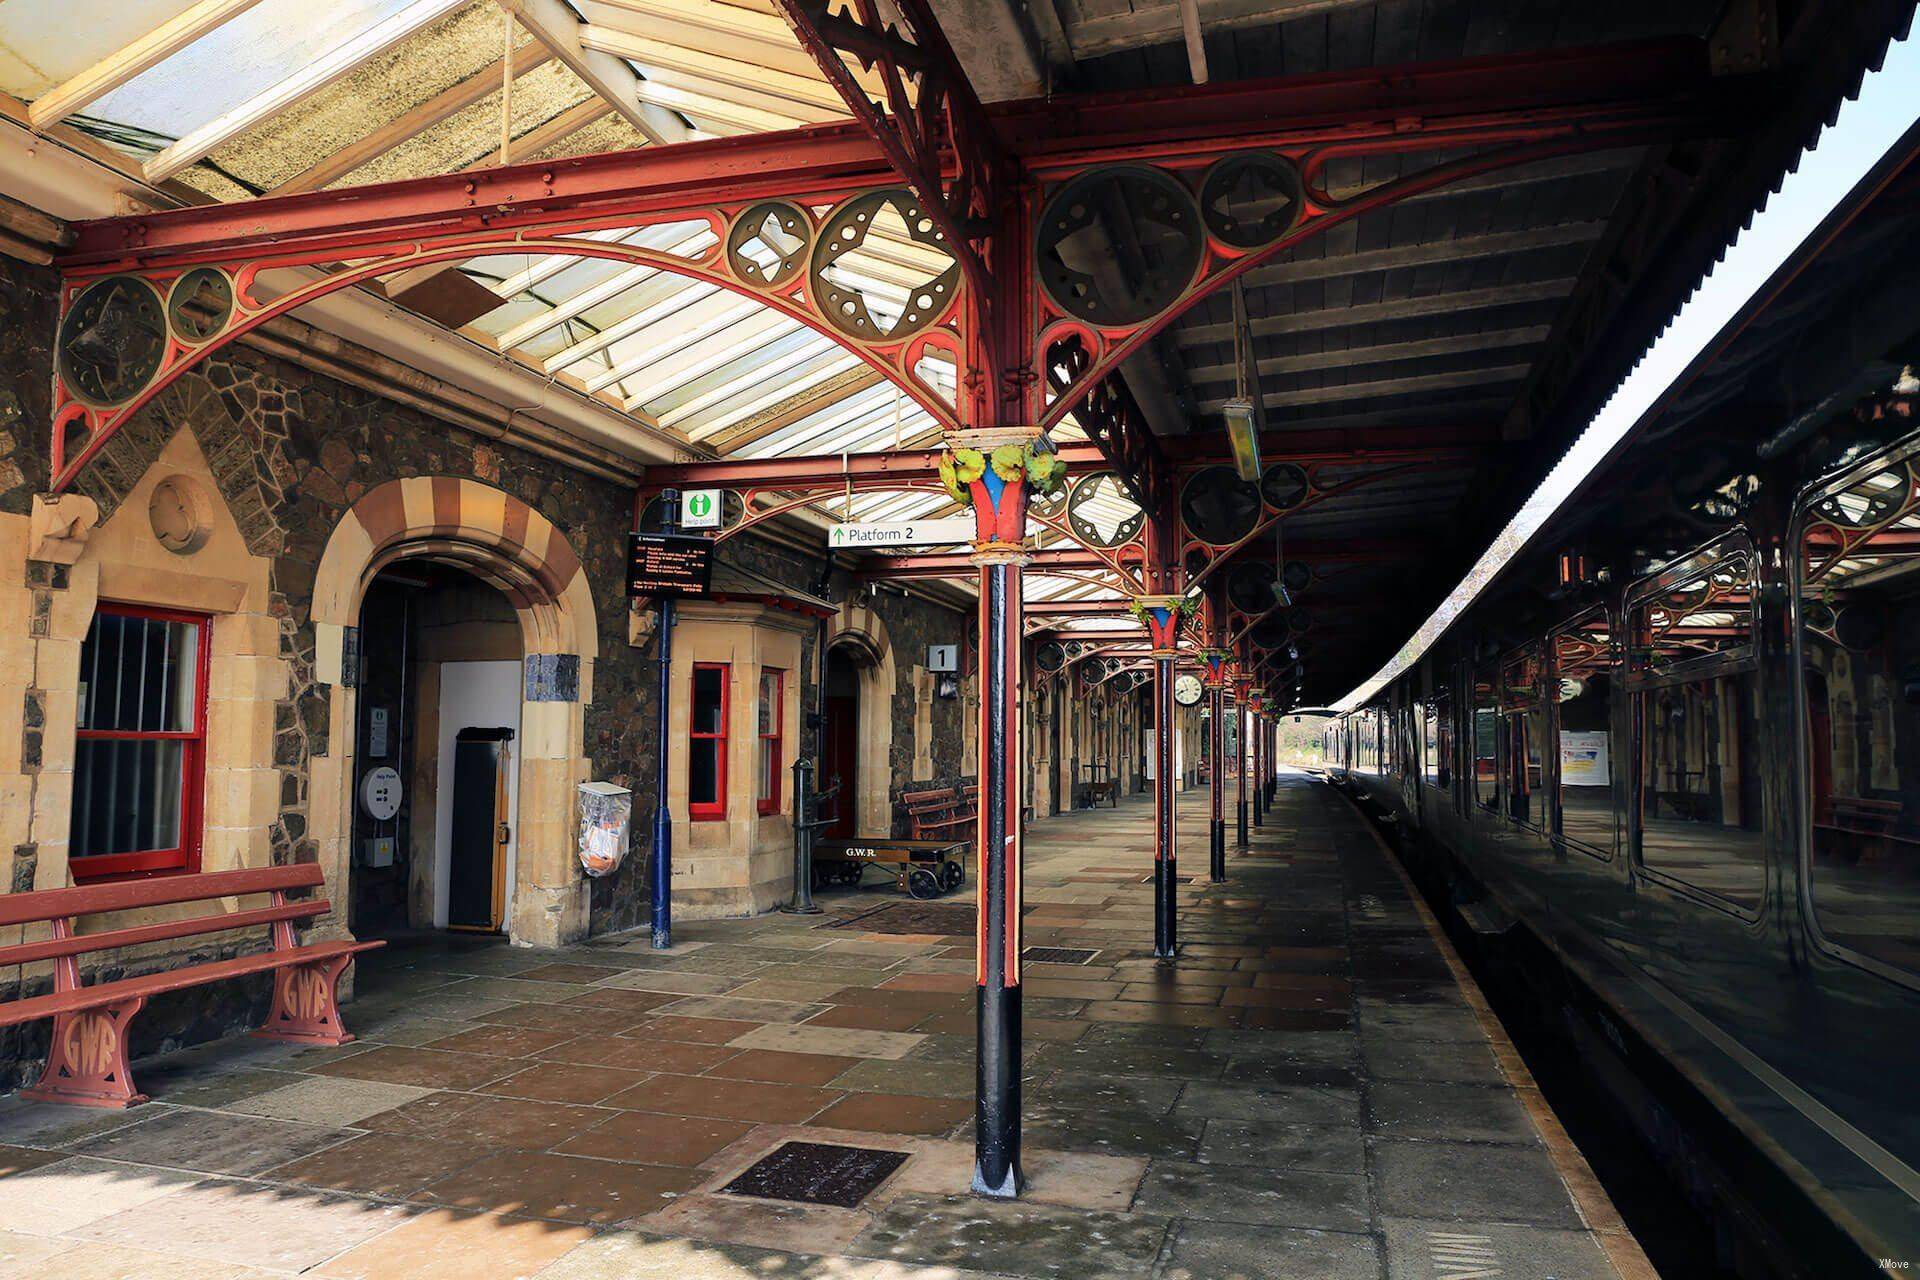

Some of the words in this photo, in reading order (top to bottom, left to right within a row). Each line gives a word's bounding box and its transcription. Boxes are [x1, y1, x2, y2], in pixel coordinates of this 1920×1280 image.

[849, 528, 900, 541] Platform
[906, 527, 913, 539] 2
[937, 649, 945, 667] 1
[283, 968, 328, 1020] GWR
[64, 1013, 116, 1077] GWR
